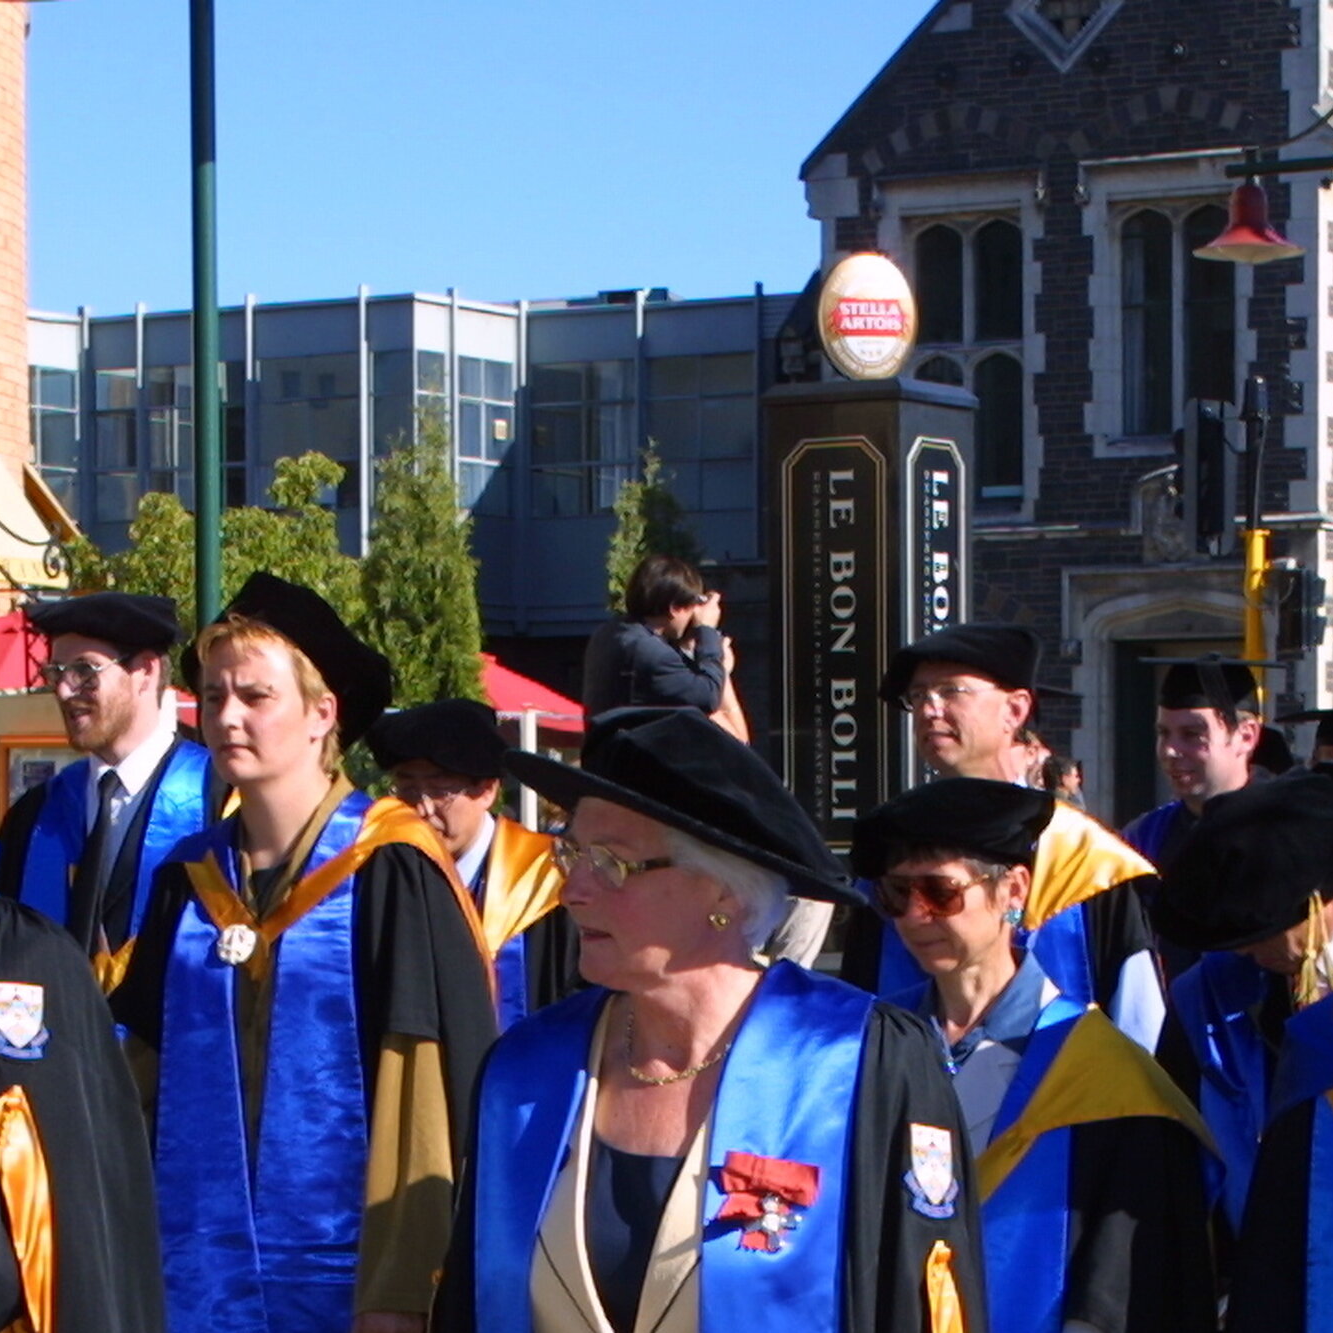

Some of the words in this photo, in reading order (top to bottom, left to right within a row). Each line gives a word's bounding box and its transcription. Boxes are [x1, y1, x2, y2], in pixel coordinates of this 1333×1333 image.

[838, 302, 901, 316] STELLA
[840, 317, 903, 330] ARTOIS
[829, 469, 855, 528] LE
[931, 469, 950, 531] LE
[830, 551, 857, 653] BON
[830, 679, 858, 819] BOLLI
